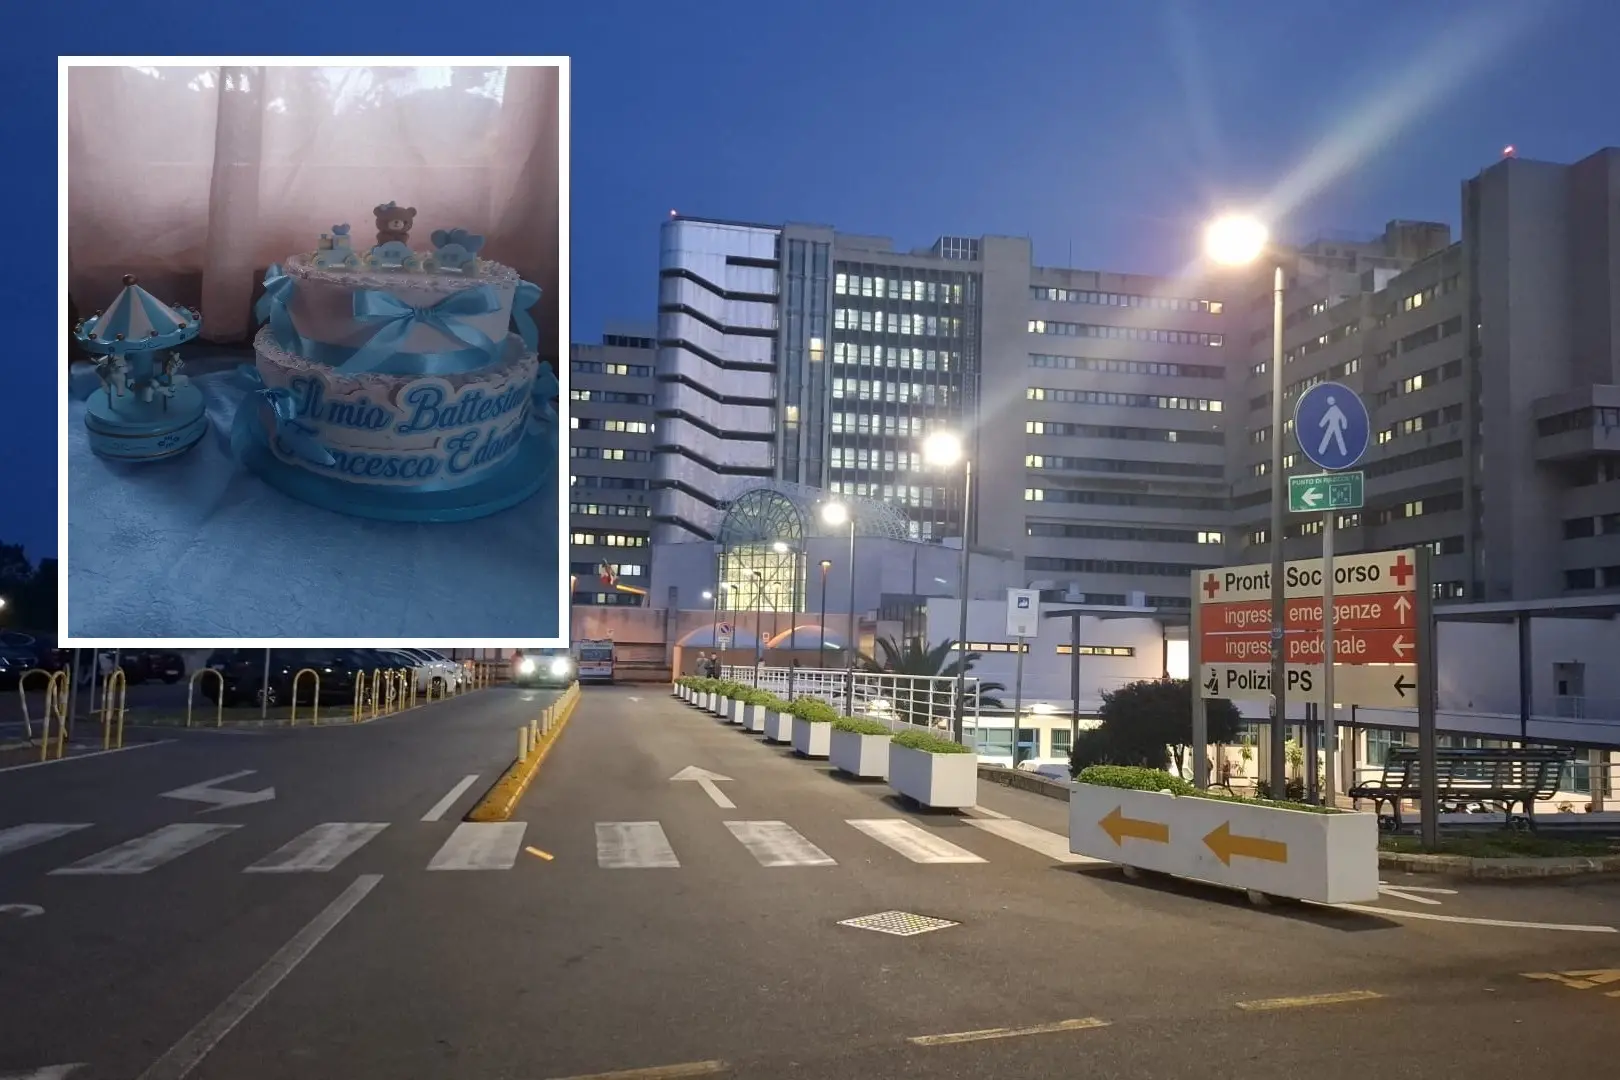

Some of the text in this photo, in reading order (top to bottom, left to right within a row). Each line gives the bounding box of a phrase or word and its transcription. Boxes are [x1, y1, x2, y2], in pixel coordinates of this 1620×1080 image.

[291, 376, 324, 418] Il
[328, 395, 390, 430] mio
[1292, 478, 1314, 487] PUNTO
[1225, 564, 1380, 592] Pront Socorso
[1225, 602, 1382, 628] ingress emegenze
[1225, 636, 1272, 659] ingress
[1226, 669, 1313, 692] Polizi PS
